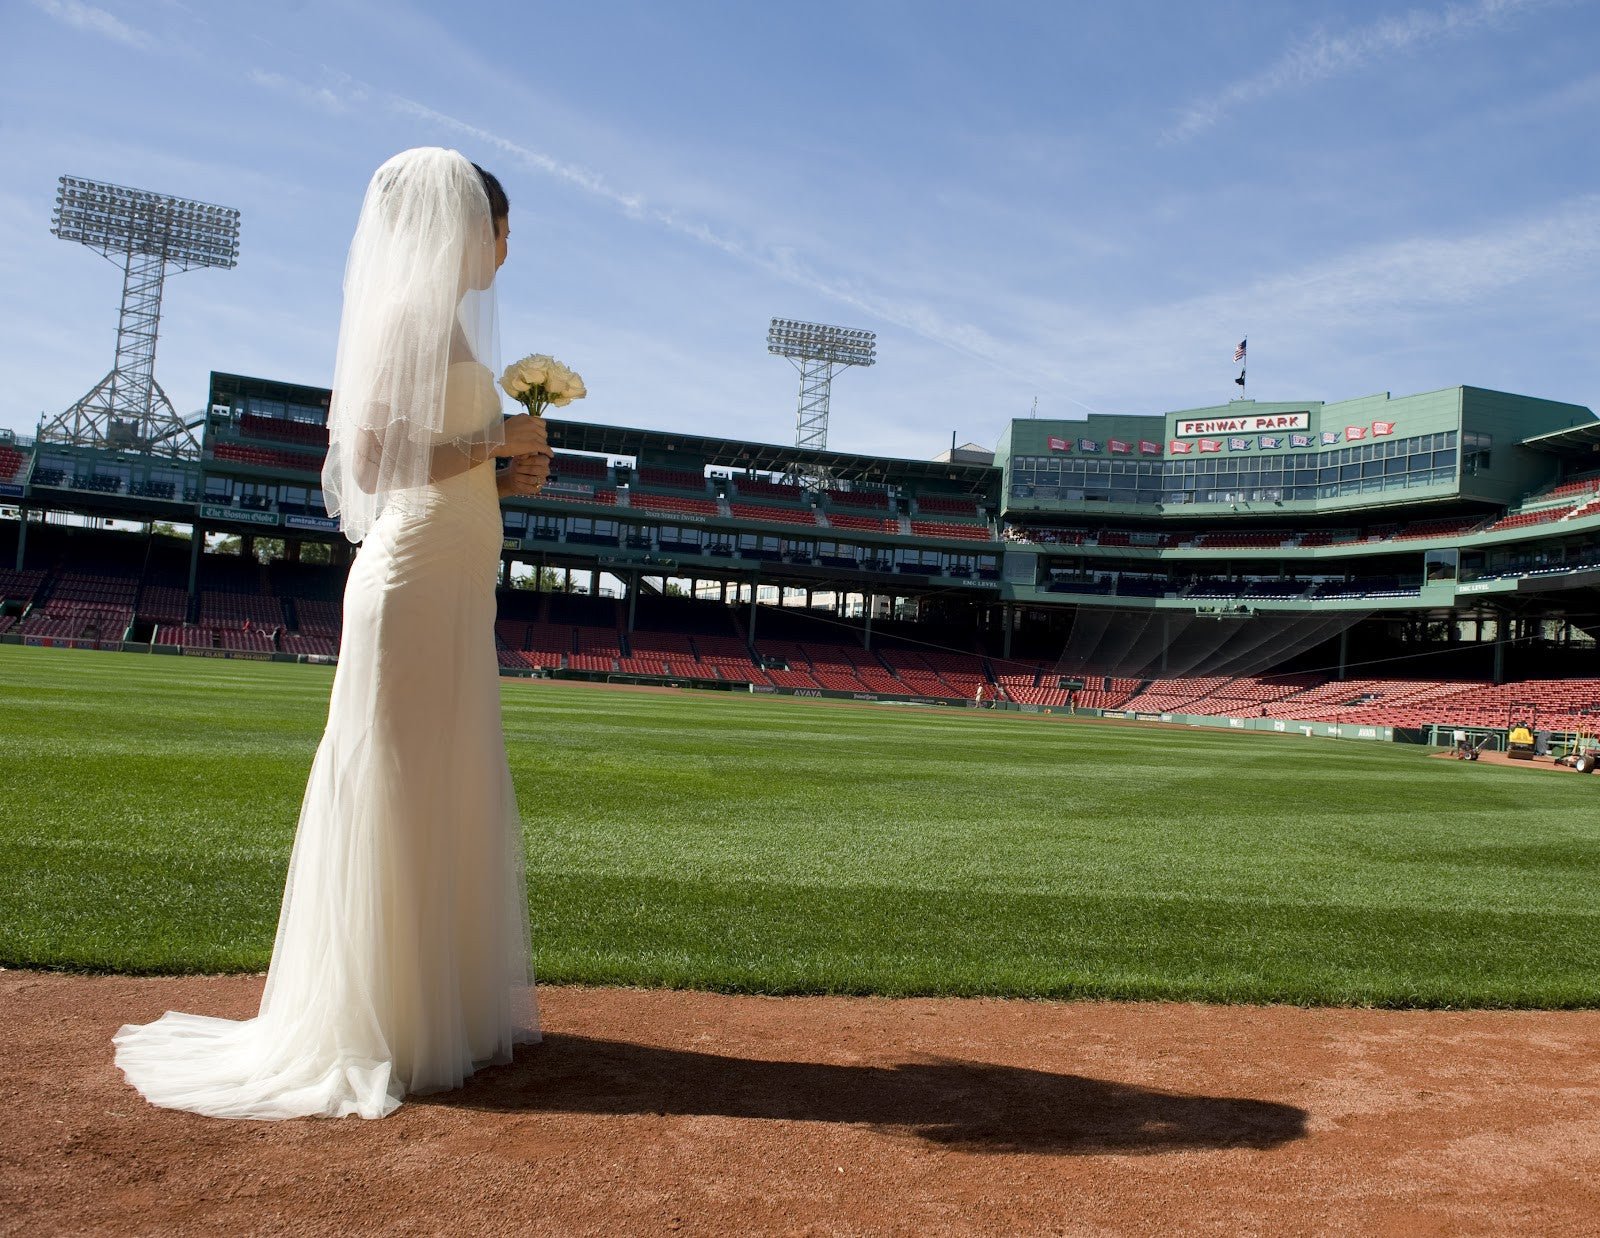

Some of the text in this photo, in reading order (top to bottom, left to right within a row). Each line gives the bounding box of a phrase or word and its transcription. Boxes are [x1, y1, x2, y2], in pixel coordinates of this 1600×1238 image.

[1185, 416, 1299, 433] FENWAY PARK
[206, 508, 274, 523] The Boston Globe
[660, 512, 680, 520] STREET
[681, 514, 706, 522] PAVILION
[289, 517, 334, 527] amtrak.com
[794, 690, 823, 698] AVAYA
